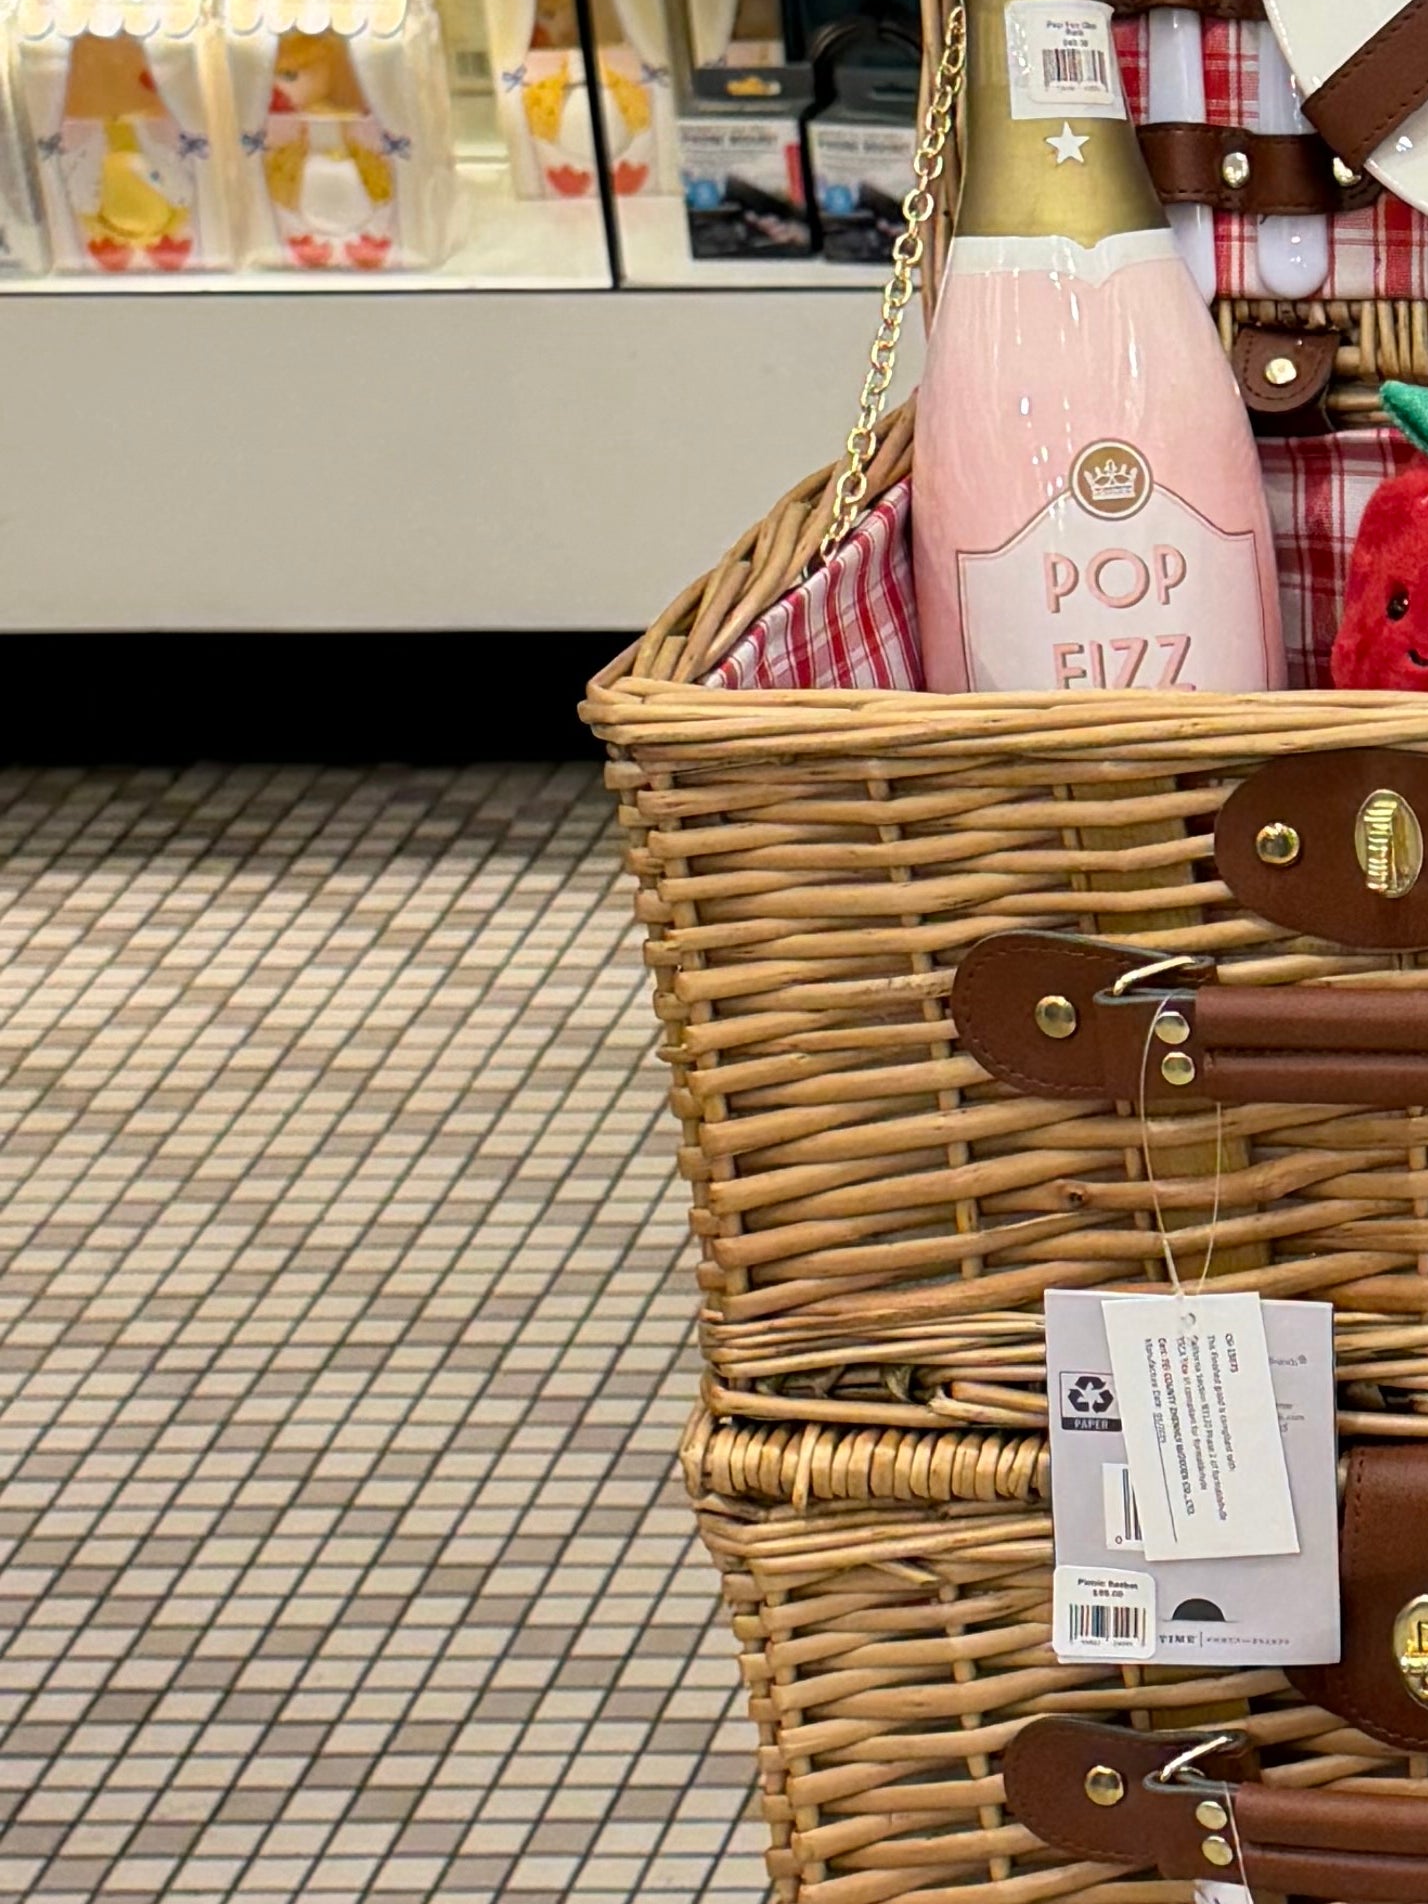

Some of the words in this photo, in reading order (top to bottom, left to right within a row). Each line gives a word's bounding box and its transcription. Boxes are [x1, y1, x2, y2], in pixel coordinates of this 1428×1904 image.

[1045, 543, 1188, 614] POP
[1053, 634, 1197, 691] FIZZ
[1074, 1420, 1108, 1431] PAPER
[1159, 1634, 1196, 1645] TIME
